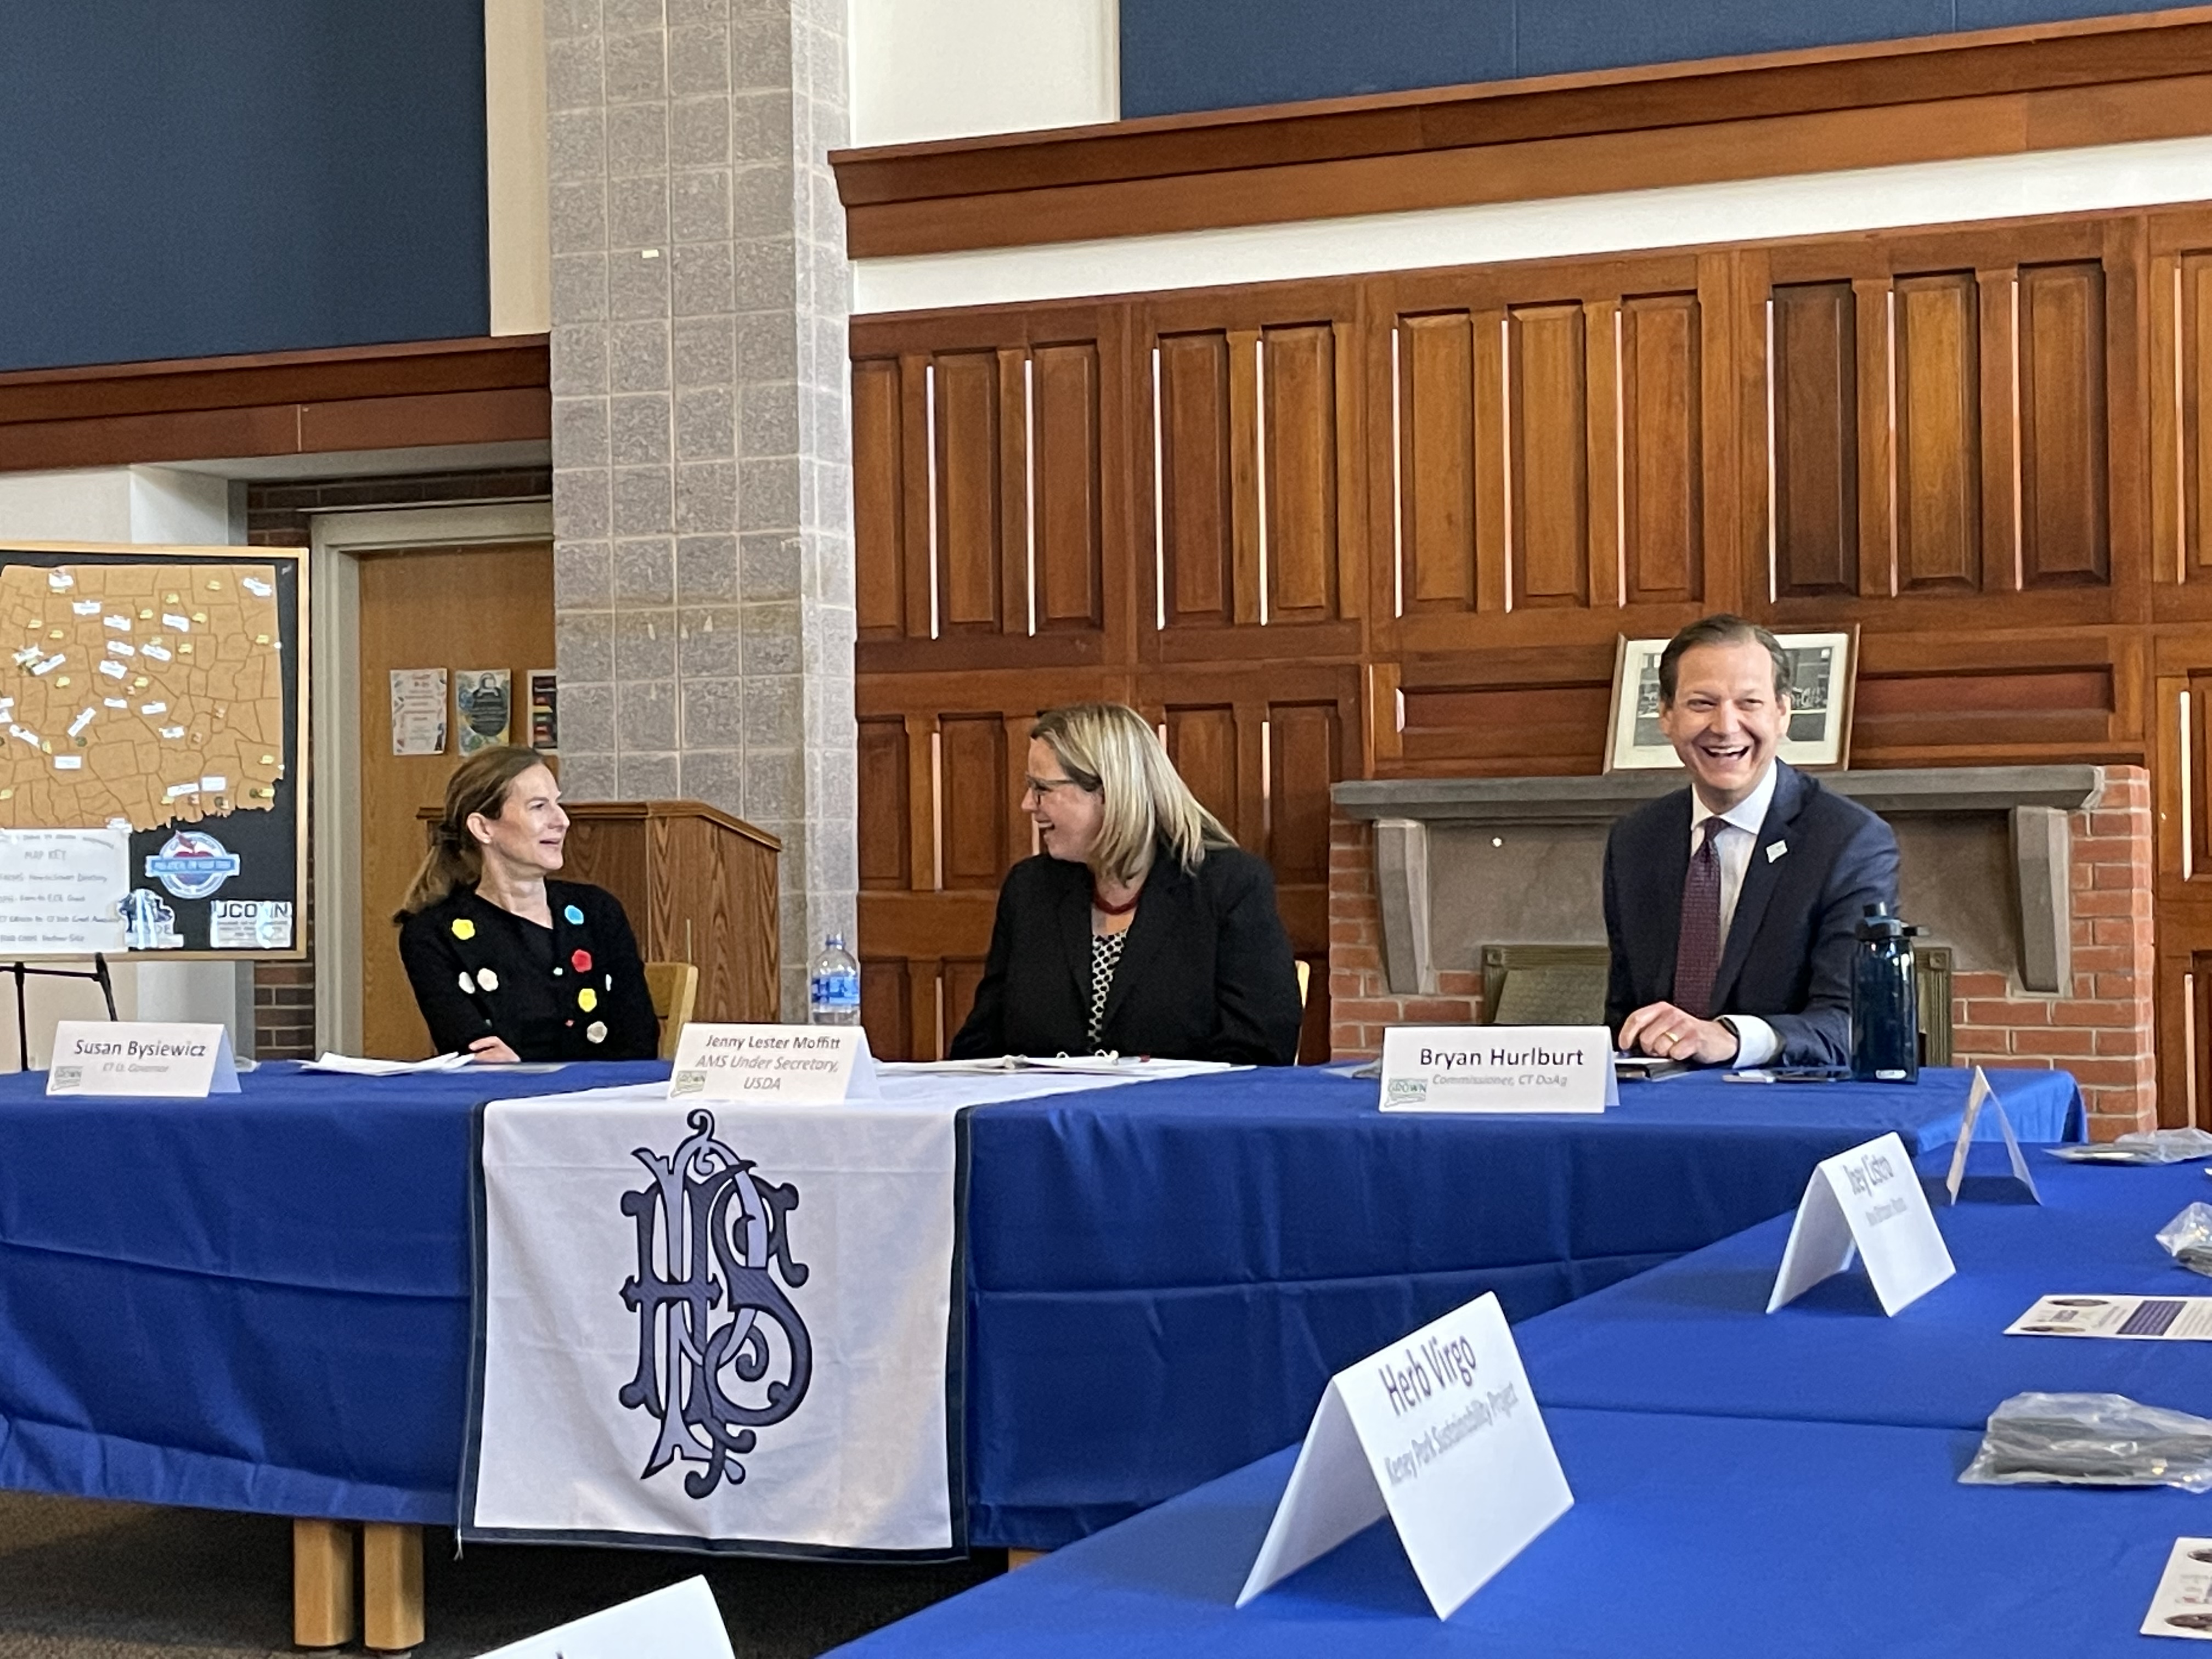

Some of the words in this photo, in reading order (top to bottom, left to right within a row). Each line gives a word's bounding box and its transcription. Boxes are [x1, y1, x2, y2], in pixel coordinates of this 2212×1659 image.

[74, 1040, 122, 1056] Susan
[127, 1041, 206, 1059] Bysiewicz
[706, 1035, 746, 1051] Jenny
[748, 1036, 790, 1049] Lester
[792, 1036, 841, 1049] Moffitt
[695, 1054, 729, 1068] AMS
[730, 1054, 771, 1070] Under
[773, 1056, 839, 1073] Secretary,
[1420, 1048, 1482, 1070] Bryan
[1490, 1047, 1584, 1066] Hurlburt
[743, 1077, 781, 1090] USDA
[1518, 1074, 1534, 1085] CT
[1378, 1348, 1431, 1417] Herb
[1420, 1335, 1477, 1388] Virgo
